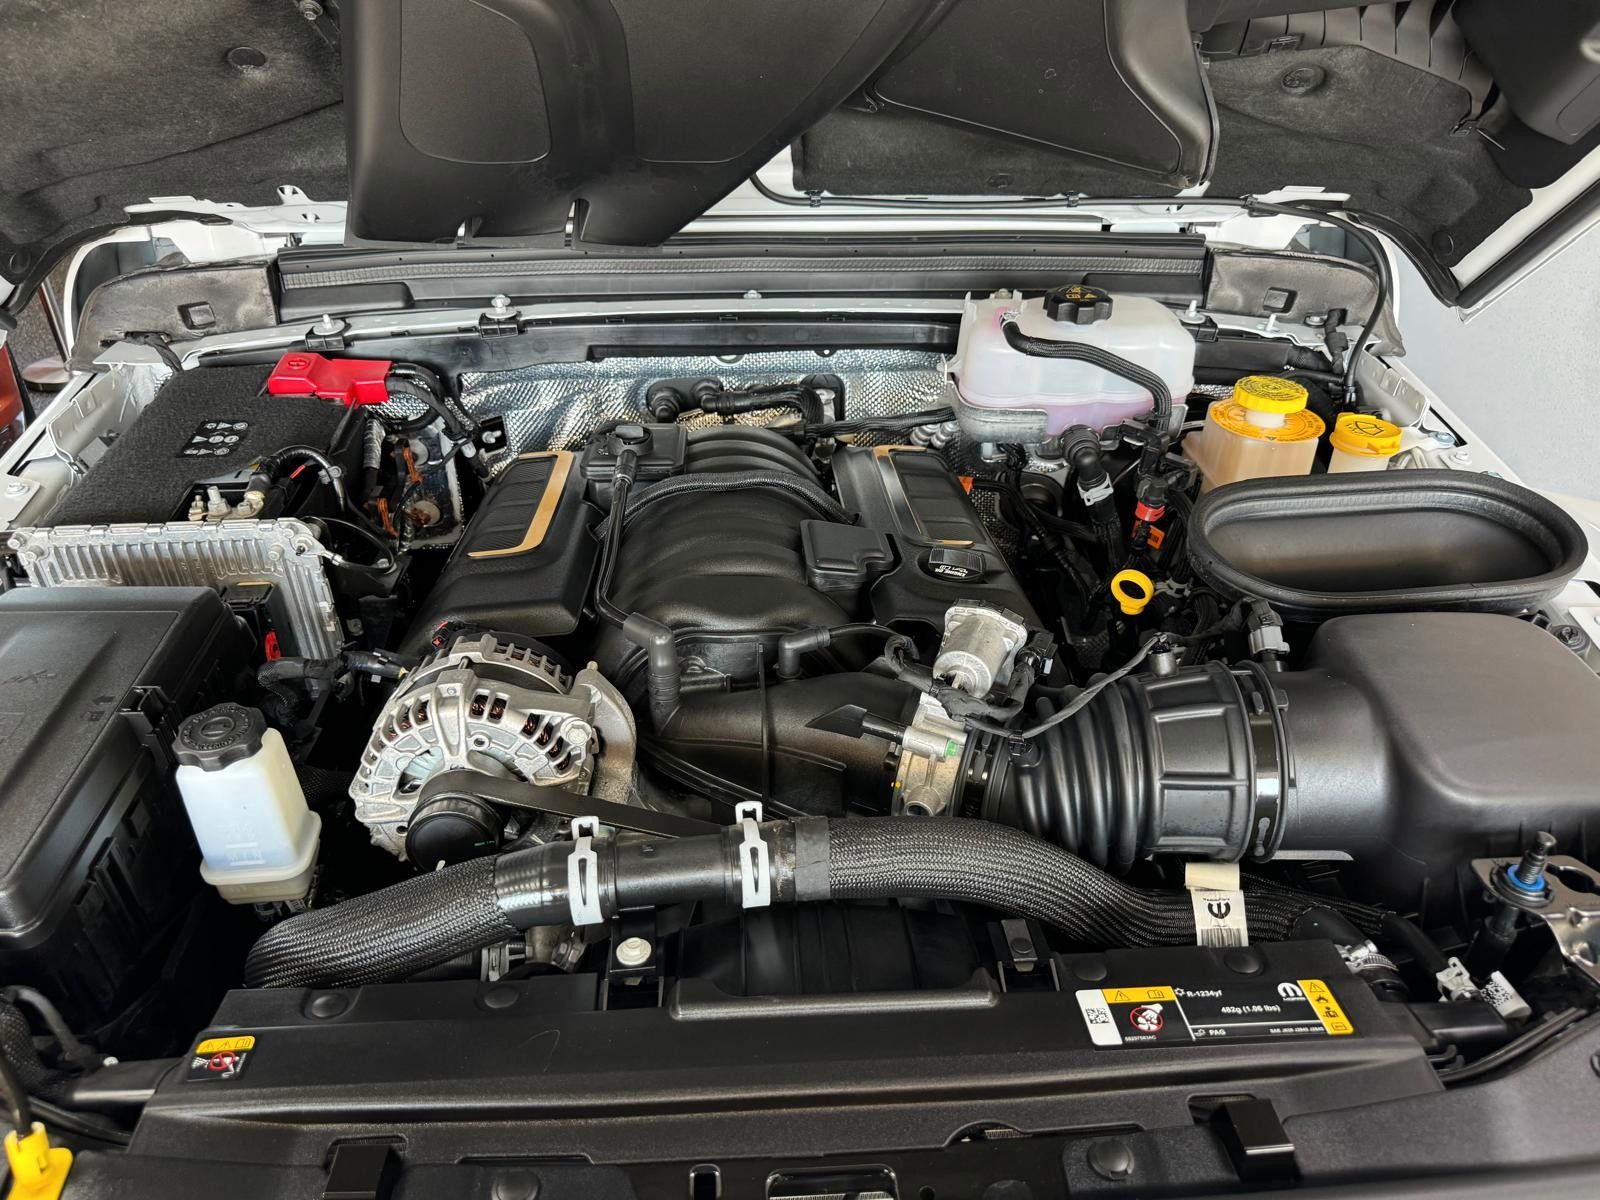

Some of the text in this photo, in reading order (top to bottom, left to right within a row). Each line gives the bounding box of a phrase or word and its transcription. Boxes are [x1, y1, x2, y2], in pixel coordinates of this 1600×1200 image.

[1186, 989, 1222, 998] R-1234yf
[1221, 1006, 1242, 1014] 482g
[1264, 1005, 1281, 1013] lbs)
